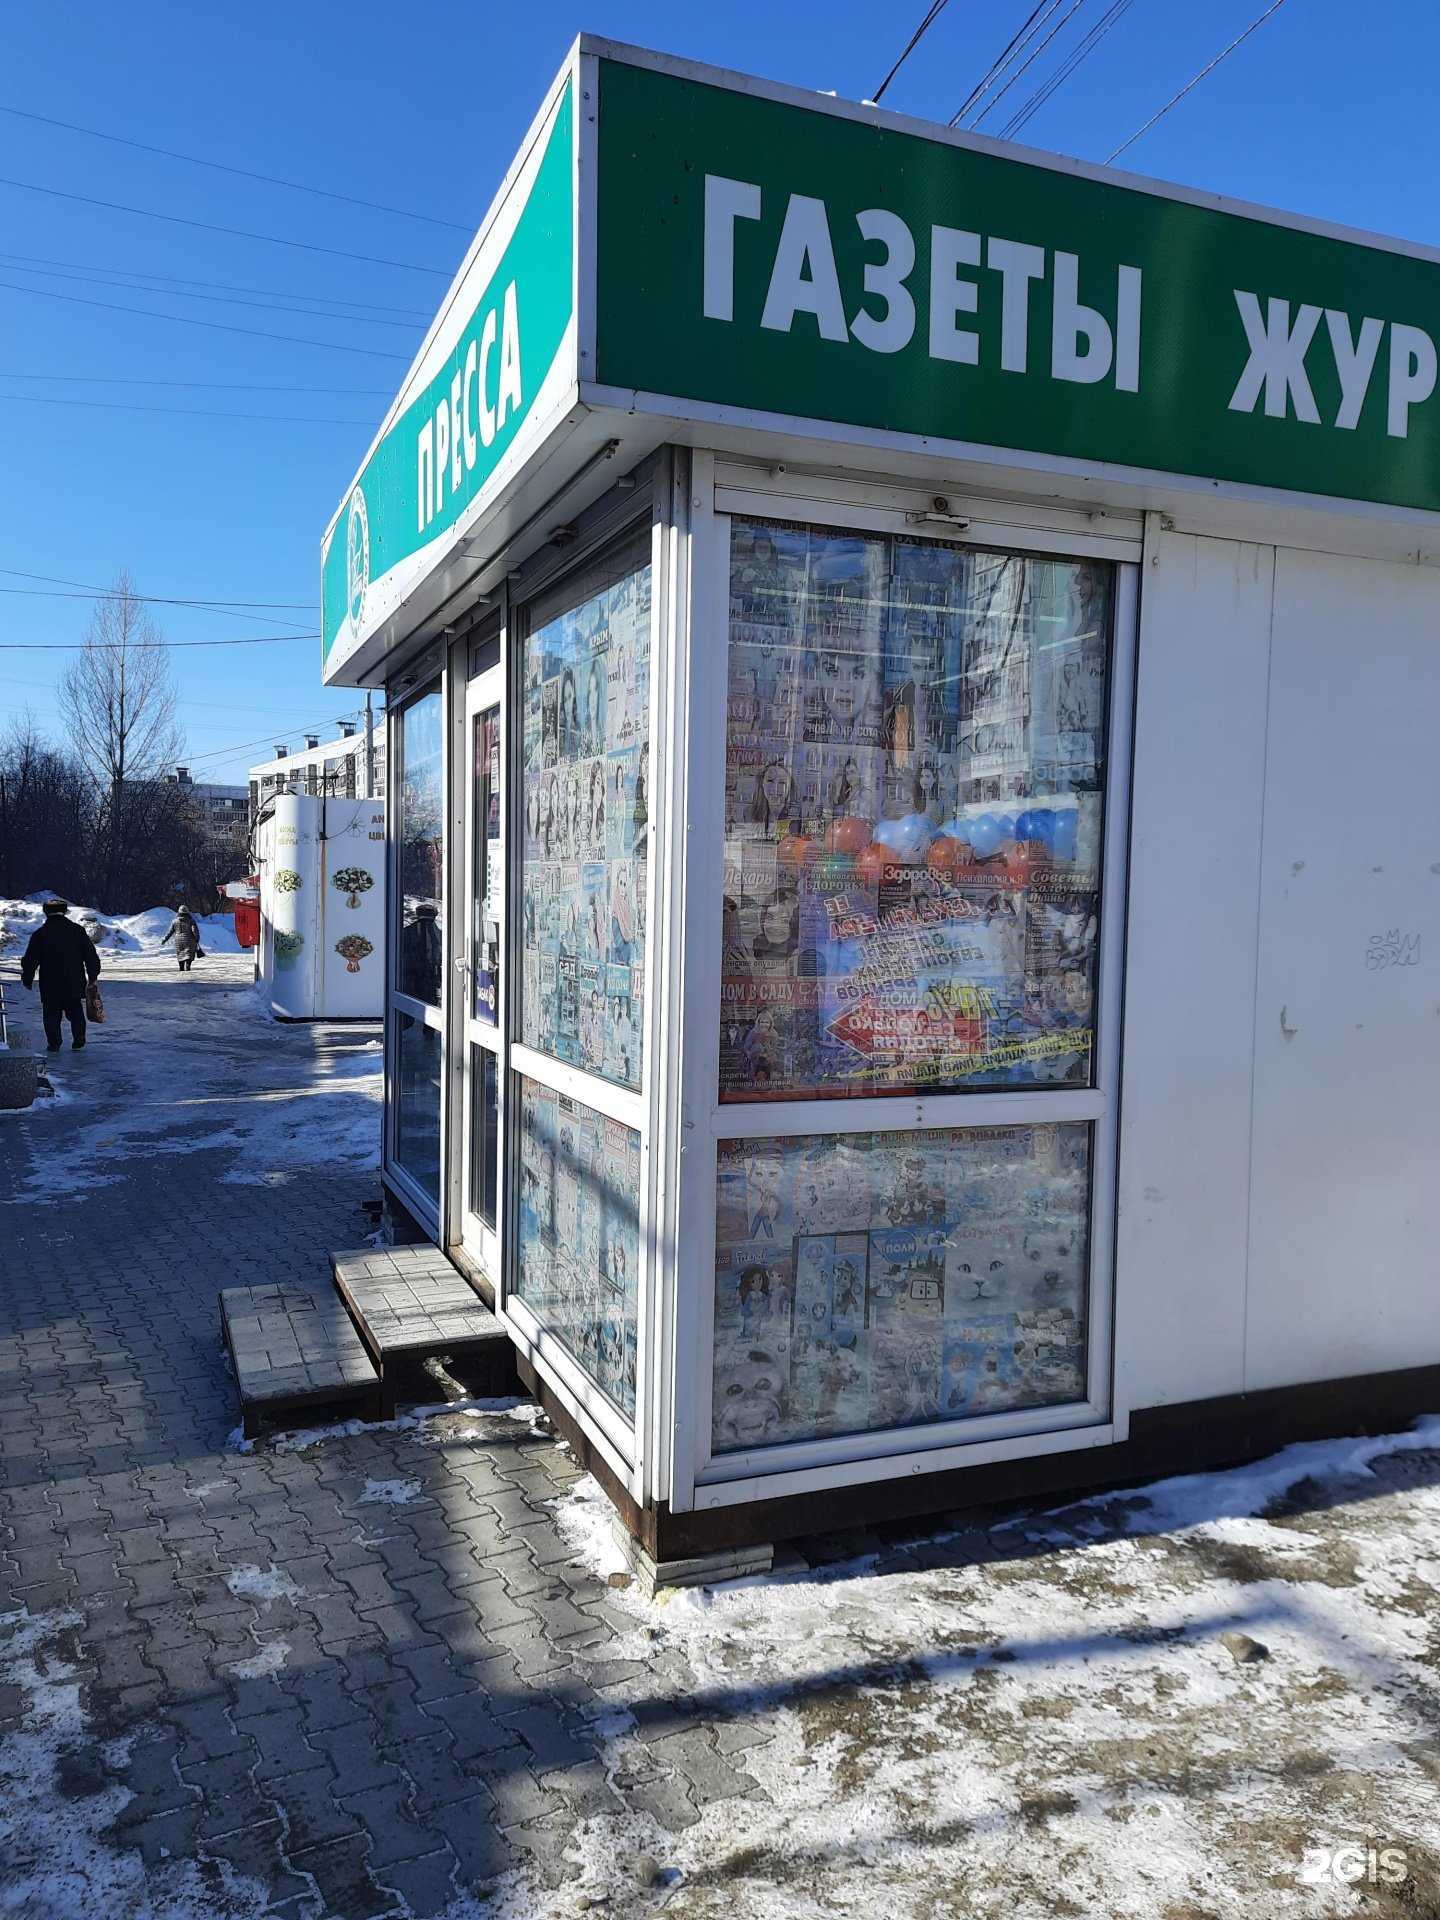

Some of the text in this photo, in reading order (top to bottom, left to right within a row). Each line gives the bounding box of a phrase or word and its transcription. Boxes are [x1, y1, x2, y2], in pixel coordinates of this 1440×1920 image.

[703, 173, 1438, 439] ГАЗЕТЫ ЖУР
[417, 279, 522, 534] ПРЕССА
[723, 868, 772, 889] Лекарь
[884, 865, 952, 884] Здоровье
[957, 871, 1009, 885] Психология
[1031, 871, 1094, 884] Советы
[760, 984, 795, 1001] САДУ
